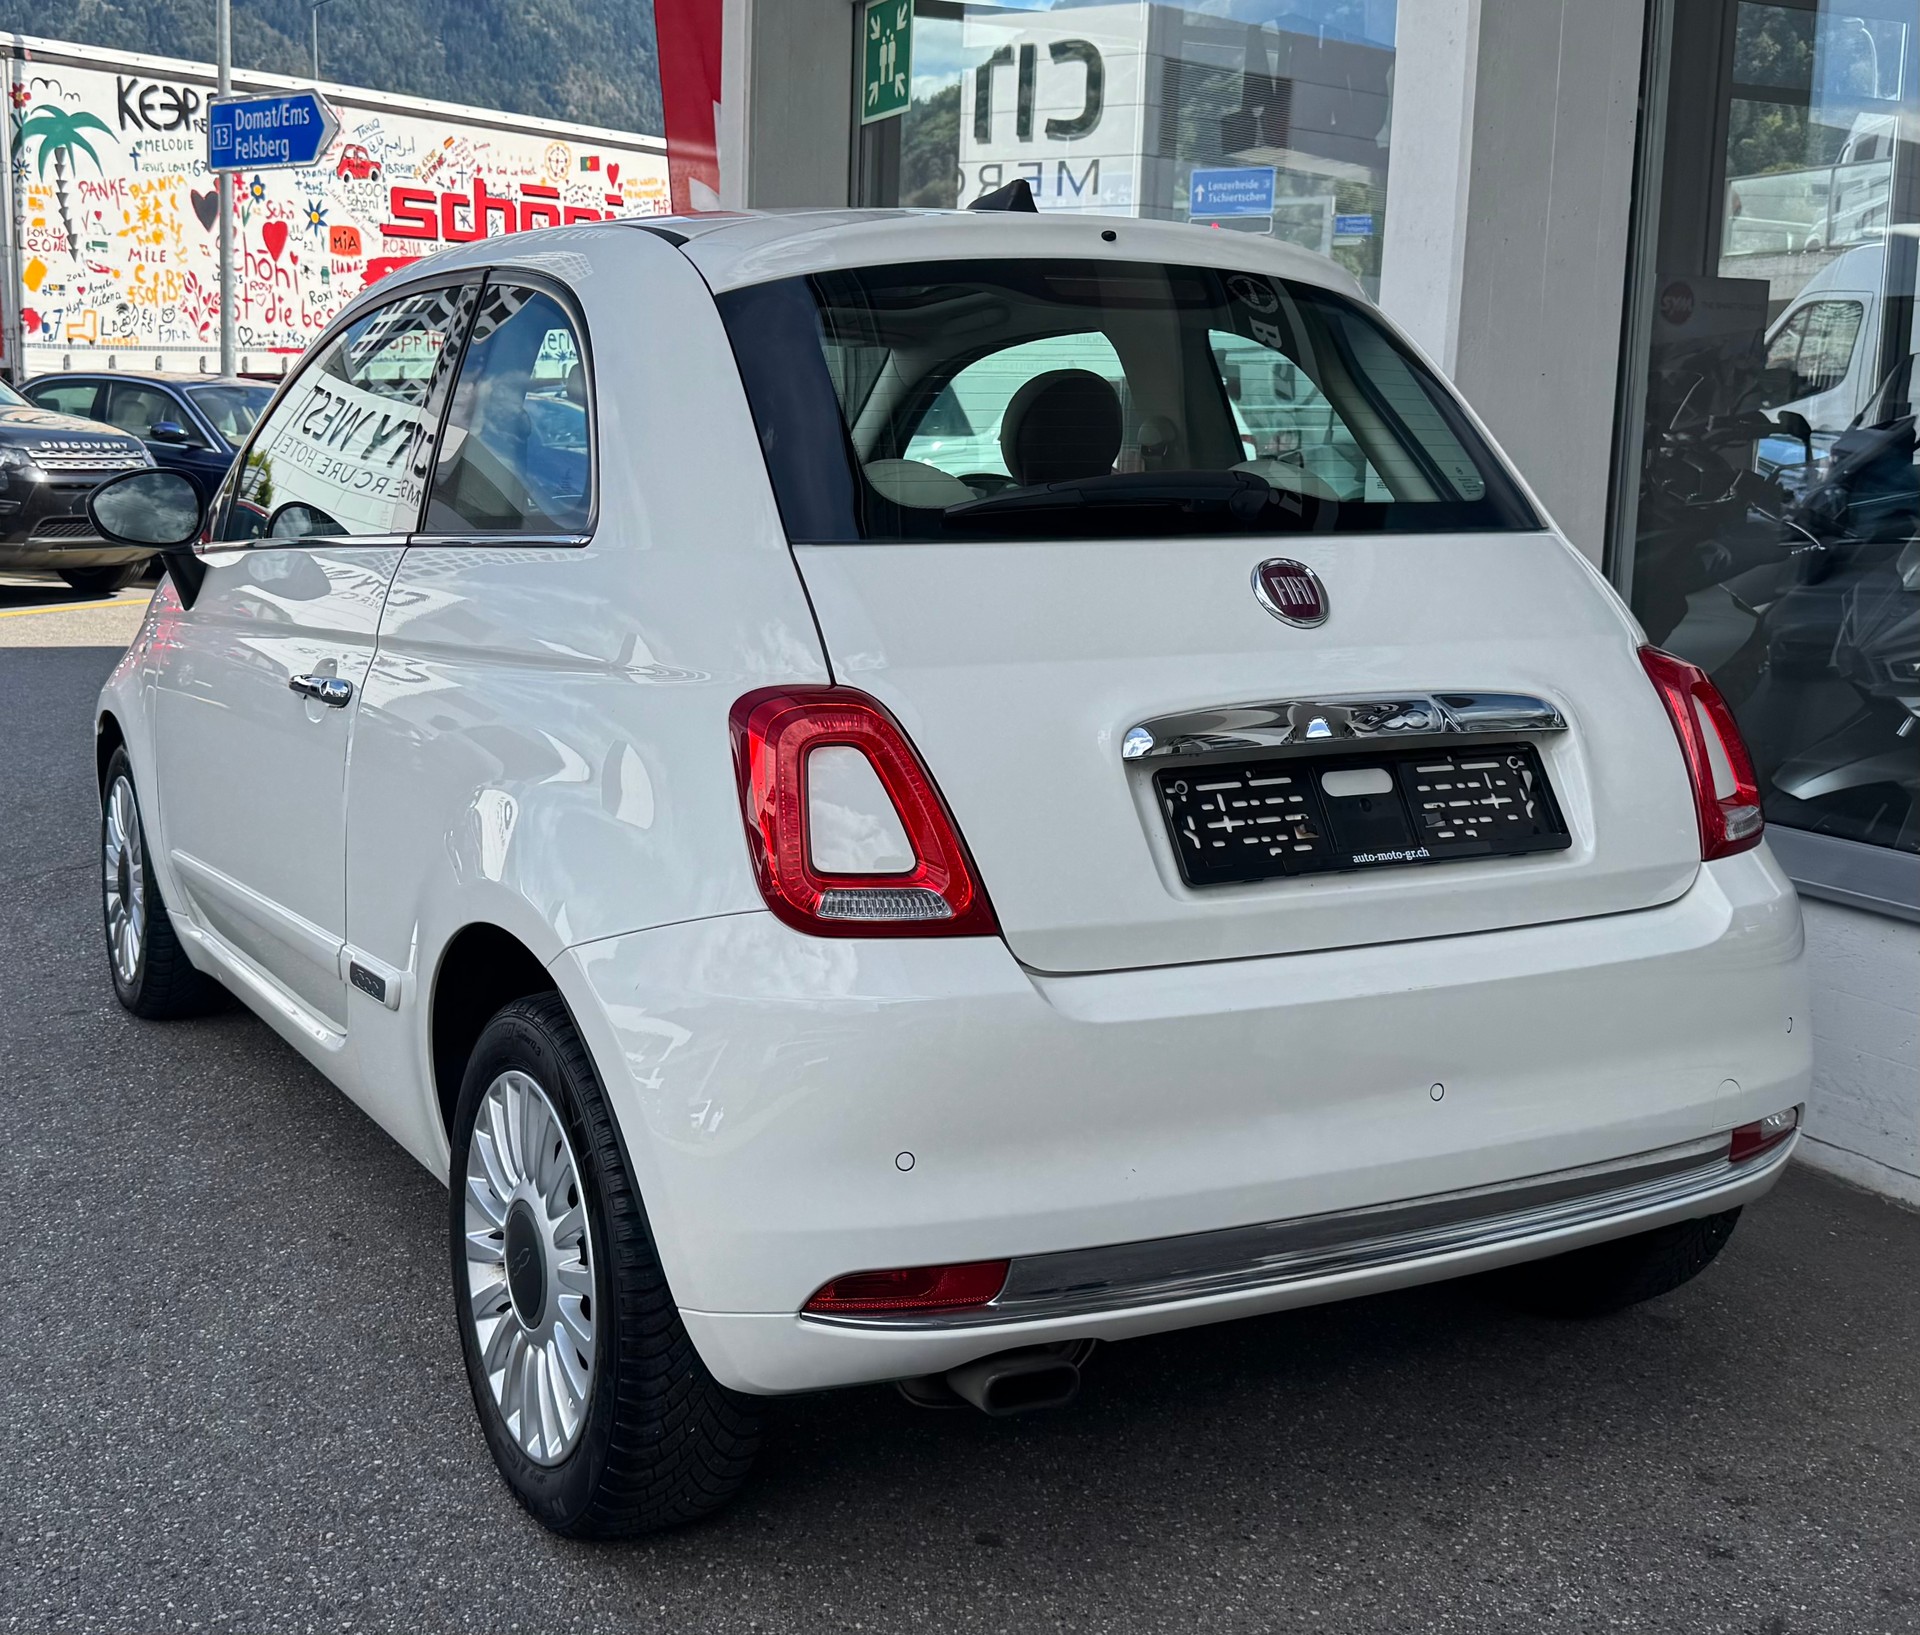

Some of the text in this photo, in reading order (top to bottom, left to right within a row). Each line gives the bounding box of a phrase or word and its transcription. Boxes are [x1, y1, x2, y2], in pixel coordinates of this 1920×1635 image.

[216, 127, 229, 147] 13
[235, 103, 310, 131] Domat/Ems
[145, 139, 194, 154] MELODIE
[235, 134, 290, 162] Felsberg
[78, 177, 129, 211] DANKE
[129, 174, 188, 200] BLANKA
[357, 183, 383, 198] 500
[265, 292, 295, 327] die
[40, 441, 129, 450] DISCOVERY
[1270, 576, 1317, 606] FIAT
[1352, 846, 1431, 863] auto-moto-gr.ch
